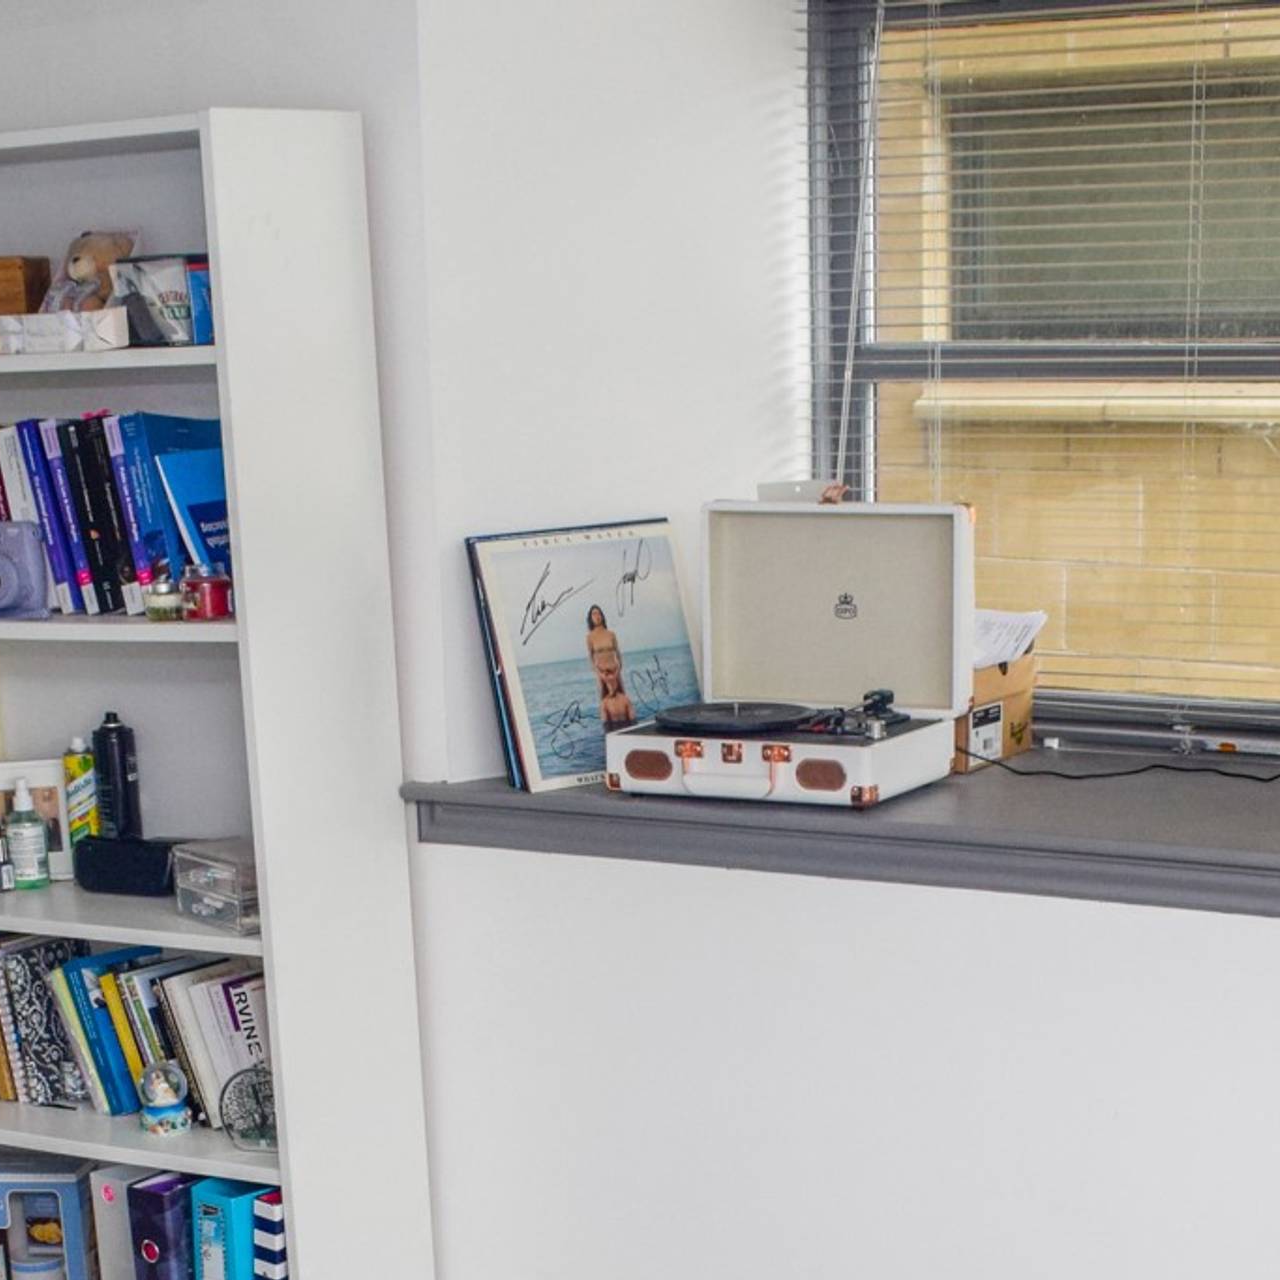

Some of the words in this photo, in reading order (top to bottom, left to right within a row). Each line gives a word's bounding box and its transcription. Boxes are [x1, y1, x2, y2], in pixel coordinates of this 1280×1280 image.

[56, 468, 64, 485] Public
[64, 504, 73, 524] Human
[70, 523, 78, 544] Rights
[126, 502, 135, 522] Human
[131, 522, 139, 543] Rights
